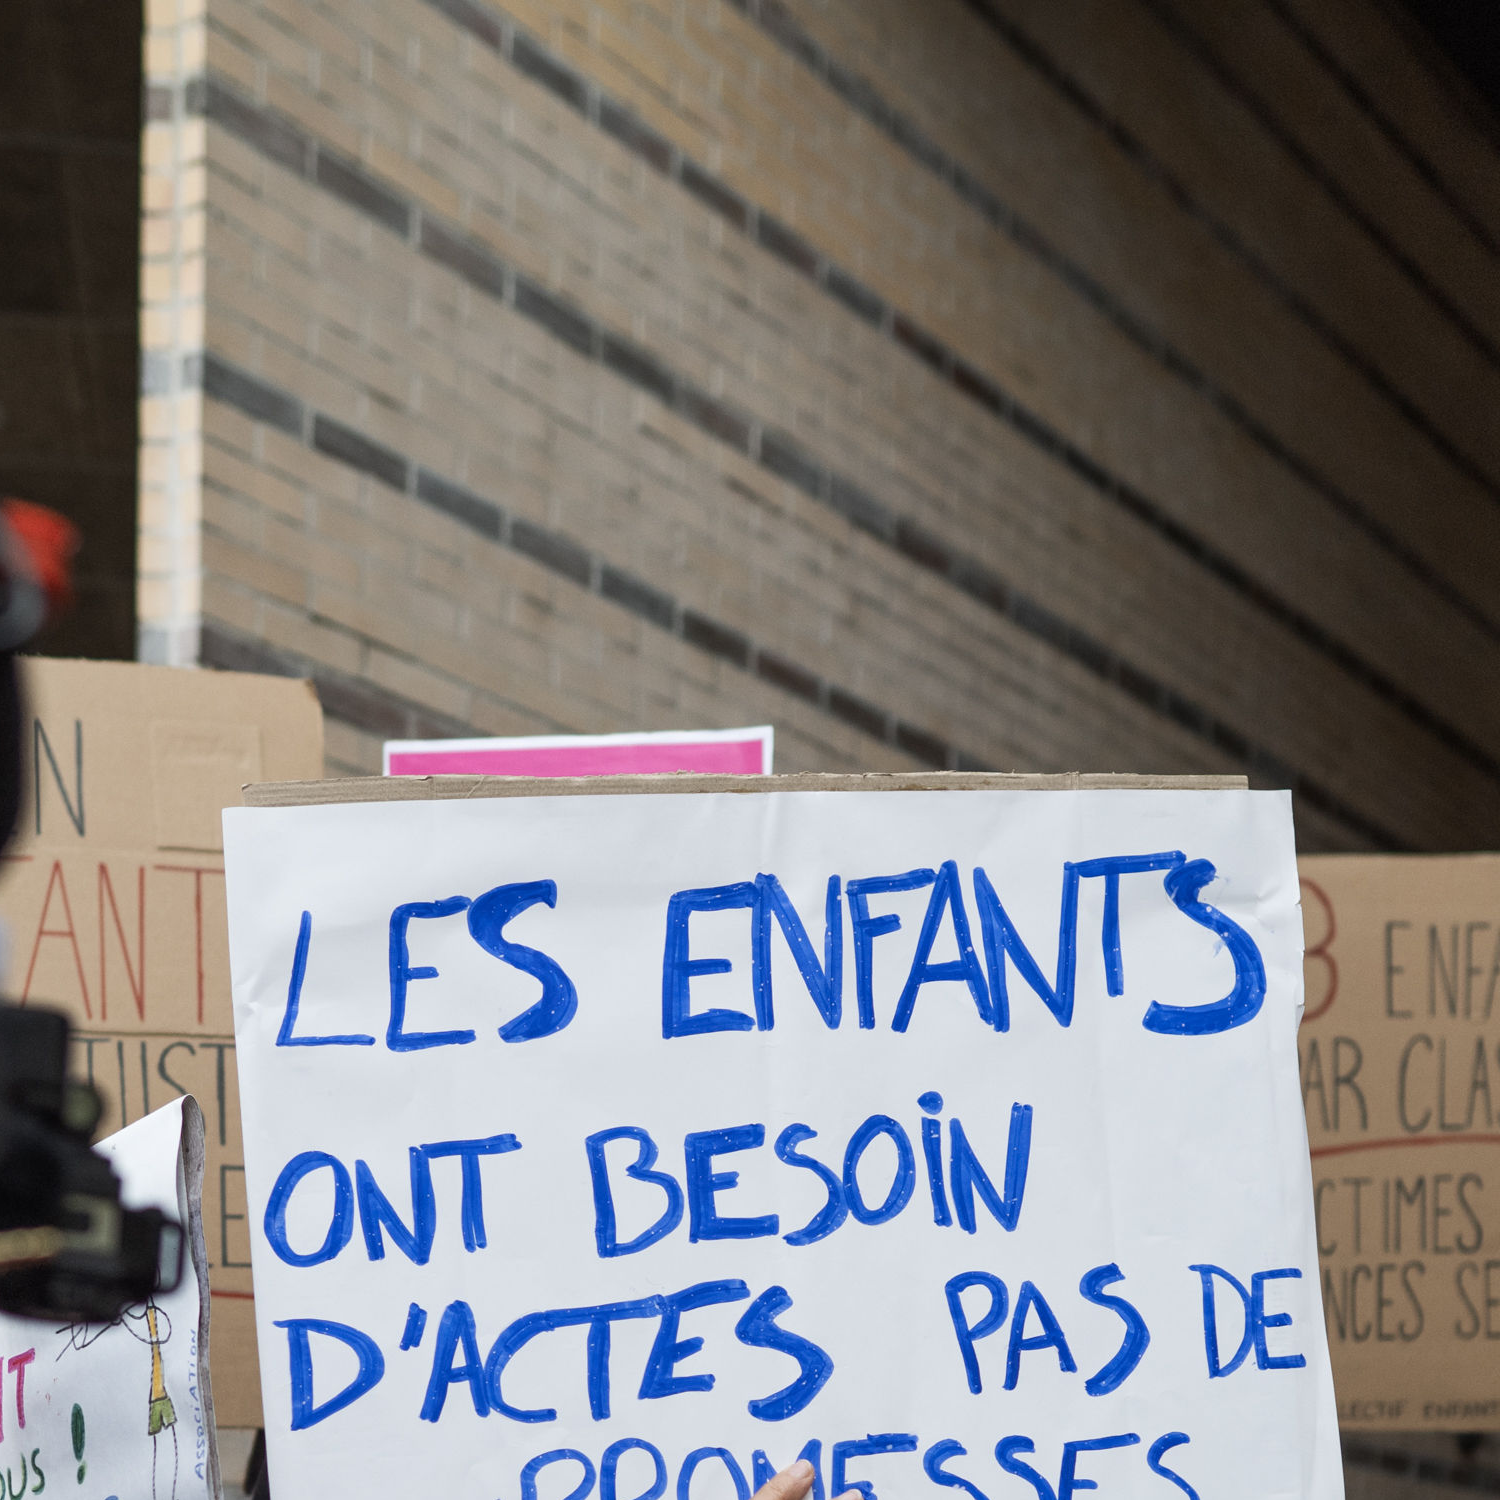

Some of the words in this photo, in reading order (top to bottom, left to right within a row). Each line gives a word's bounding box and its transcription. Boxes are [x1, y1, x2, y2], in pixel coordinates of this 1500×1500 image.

[275, 879, 579, 1053] LES
[661, 850, 1268, 1039] ENFANTS
[263, 1133, 522, 1267] ONT
[273, 1279, 835, 1430] D'ACTES
[944, 1262, 1151, 1397] PAS
[1188, 1263, 1308, 1380] DE
